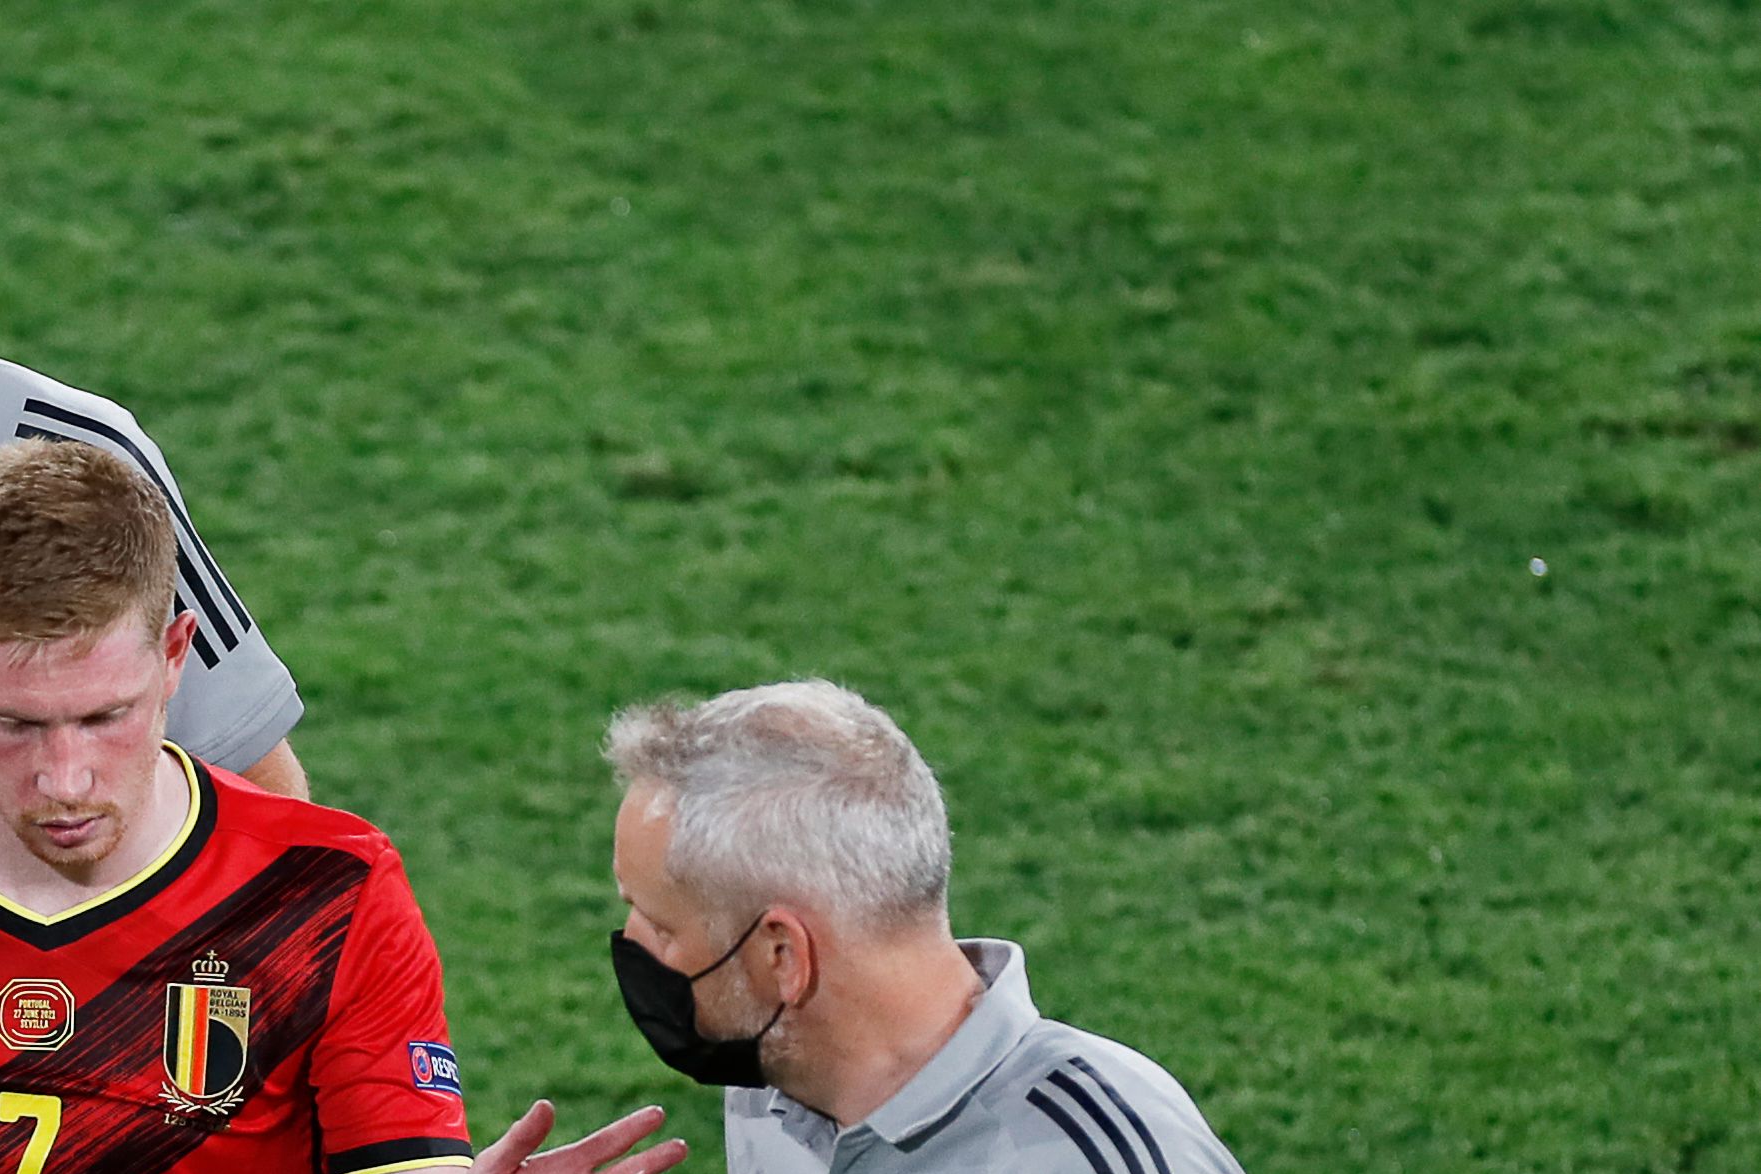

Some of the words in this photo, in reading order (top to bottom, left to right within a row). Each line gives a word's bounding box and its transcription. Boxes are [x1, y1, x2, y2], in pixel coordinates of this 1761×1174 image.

[210, 989, 238, 999] ROYAL
[18, 999, 51, 1009] PORTUGAL
[209, 999, 247, 1009] BELGIAN
[13, 1009, 22, 1019] 27
[22, 1009, 39, 1019] JUNE
[40, 1010, 56, 1020] 2021
[20, 1018, 49, 1029] SEVILLA
